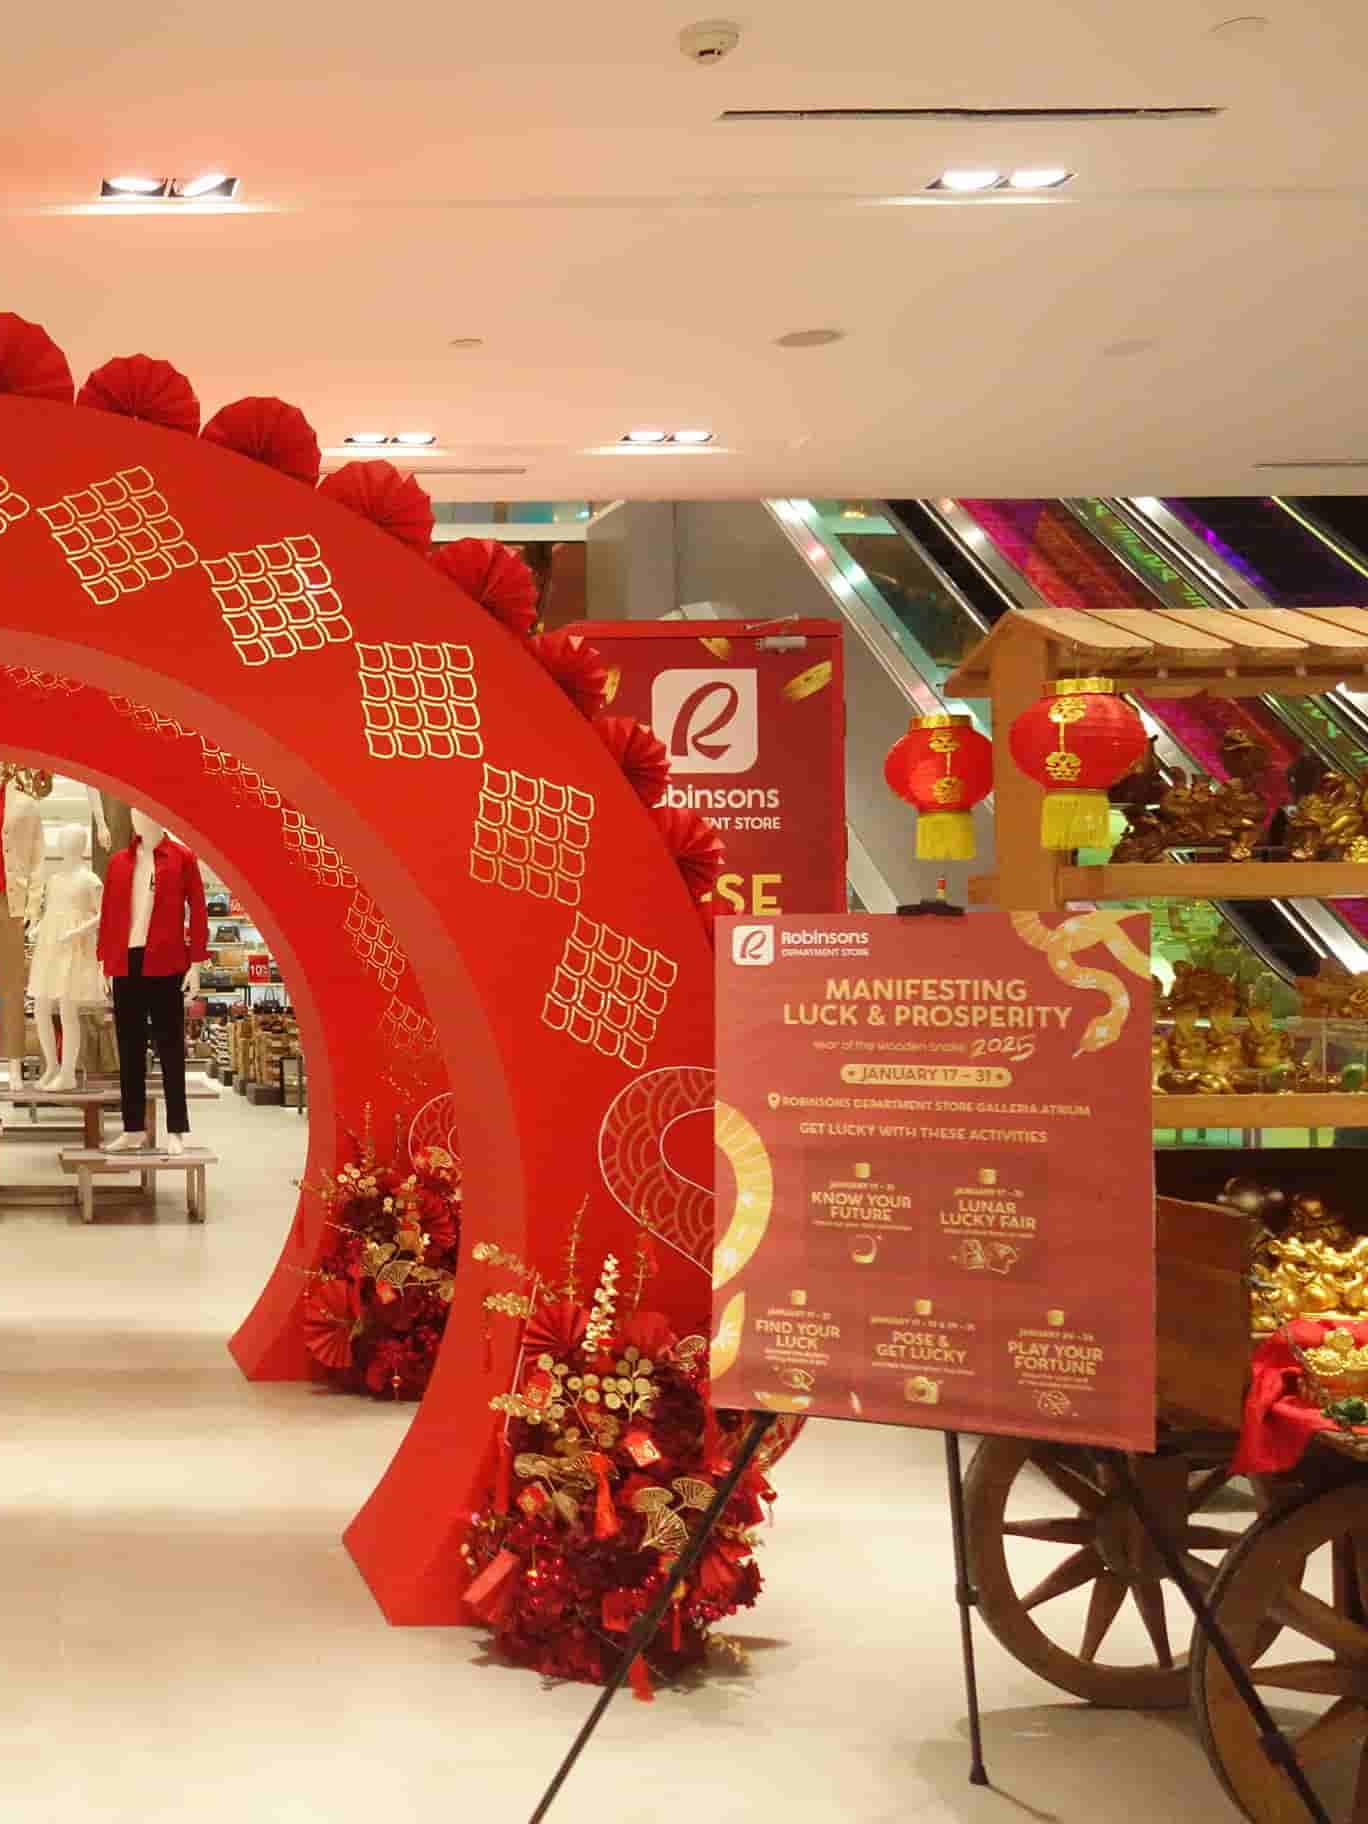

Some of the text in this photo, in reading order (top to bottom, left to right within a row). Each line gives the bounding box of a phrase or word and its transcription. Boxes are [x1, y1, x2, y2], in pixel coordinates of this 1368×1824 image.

[735, 816, 781, 830] STORE
[781, 929, 869, 945] Robinsons
[825, 979, 1027, 1001] MANIFESTING
[783, 1003, 1073, 1029] LUCK & PROSPERITY
[969, 1033, 1036, 1062] 2025
[860, 1065, 938, 1081] JANUARY
[943, 1068, 959, 1081] 17
[975, 1068, 991, 1082] 31
[782, 1096, 1091, 1117] ROBINSONS DEPARTMENT STORE GALLERIA ATRIUM
[799, 1121, 1048, 1144] GET LUCKY WITH THESE ACTIVITIES
[811, 1191, 912, 1209] KNOW YOUR
[959, 1199, 1017, 1215] LUNAR
[830, 1206, 893, 1222] FUTURE
[940, 1210, 1037, 1231] LUCKY FAIR
[754, 1319, 841, 1338] FIND YOUR
[893, 1330, 935, 1346] POSE
[775, 1334, 819, 1350] LUCK
[1007, 1341, 1105, 1361] PLAY YOUR
[875, 1343, 969, 1365] GET LUCKY
[1014, 1355, 1097, 1377] FORTUNE
